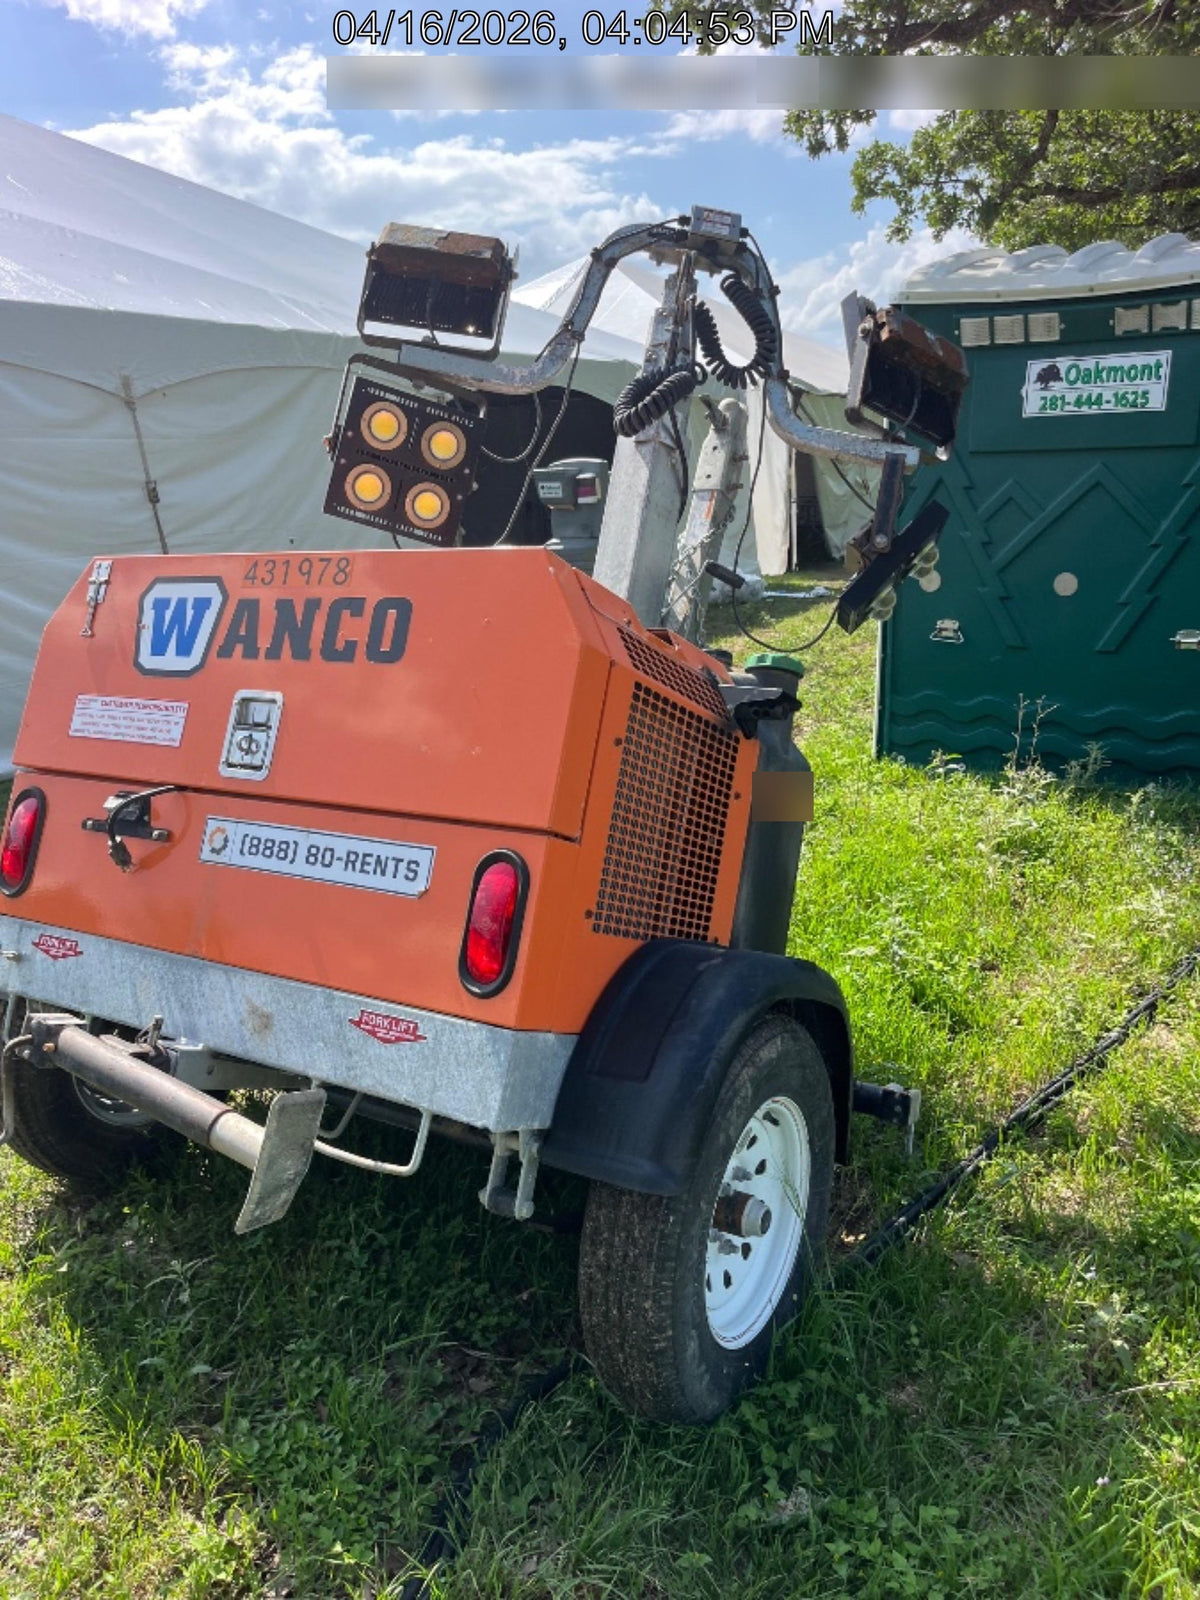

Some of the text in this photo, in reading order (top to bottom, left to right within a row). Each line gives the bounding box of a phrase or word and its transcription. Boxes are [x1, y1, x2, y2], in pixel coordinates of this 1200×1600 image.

[1064, 359, 1163, 386] Oakmont
[1039, 390, 1149, 411] 281-444-1625
[244, 557, 350, 585] 431978
[150, 597, 413, 663] WANCO
[239, 833, 420, 882] (888) 80-RENTS
